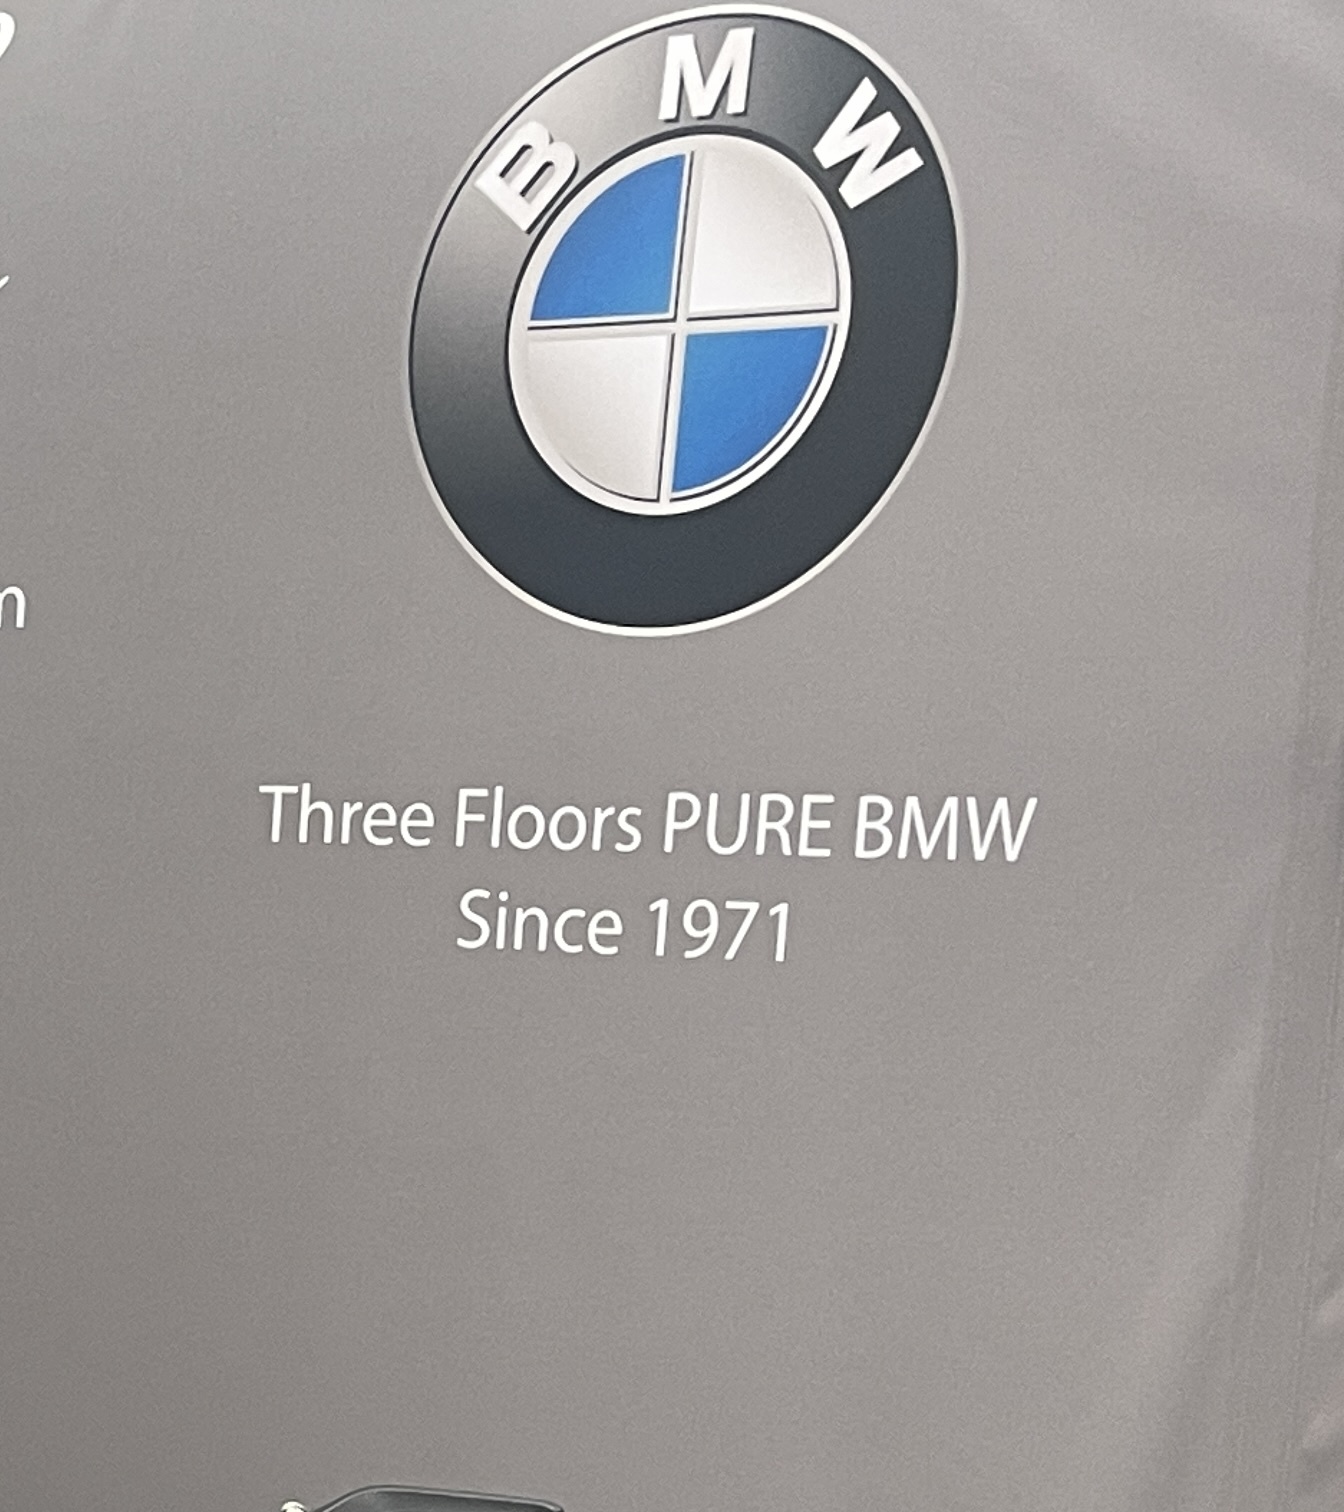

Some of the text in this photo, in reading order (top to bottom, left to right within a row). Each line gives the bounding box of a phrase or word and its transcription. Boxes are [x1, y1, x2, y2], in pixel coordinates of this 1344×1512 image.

[473, 27, 925, 234] BMW
[258, 782, 1038, 862] Three Floors PURE BMW
[456, 888, 790, 963] Since 1971
